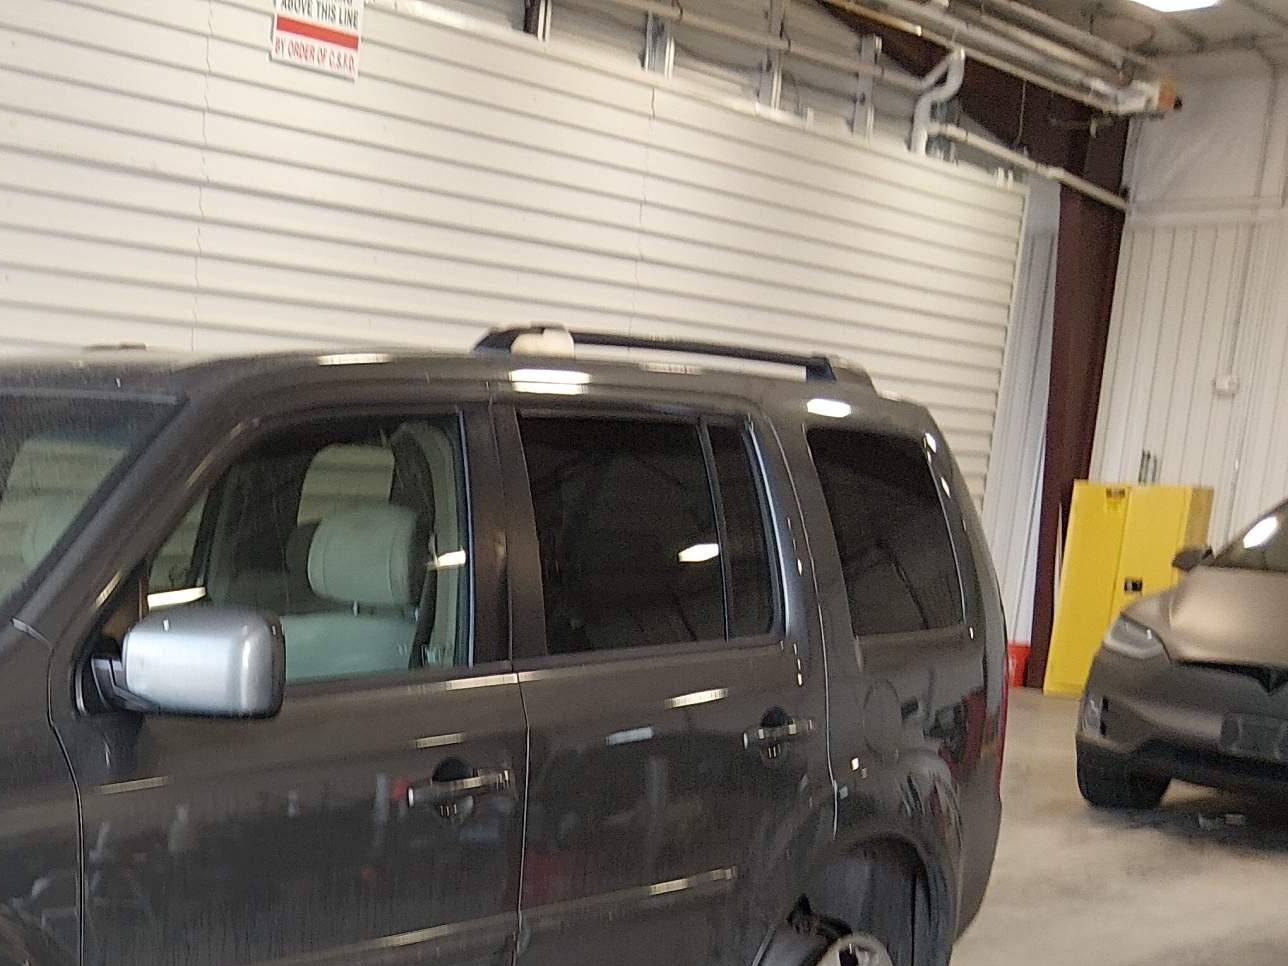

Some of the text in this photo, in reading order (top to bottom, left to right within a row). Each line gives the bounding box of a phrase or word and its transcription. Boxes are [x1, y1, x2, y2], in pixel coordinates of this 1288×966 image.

[280, 0, 359, 30] ABOVE THIS LINE
[275, 37, 286, 56] BY
[288, 39, 315, 64] ORDER
[317, 48, 327, 65] OF
